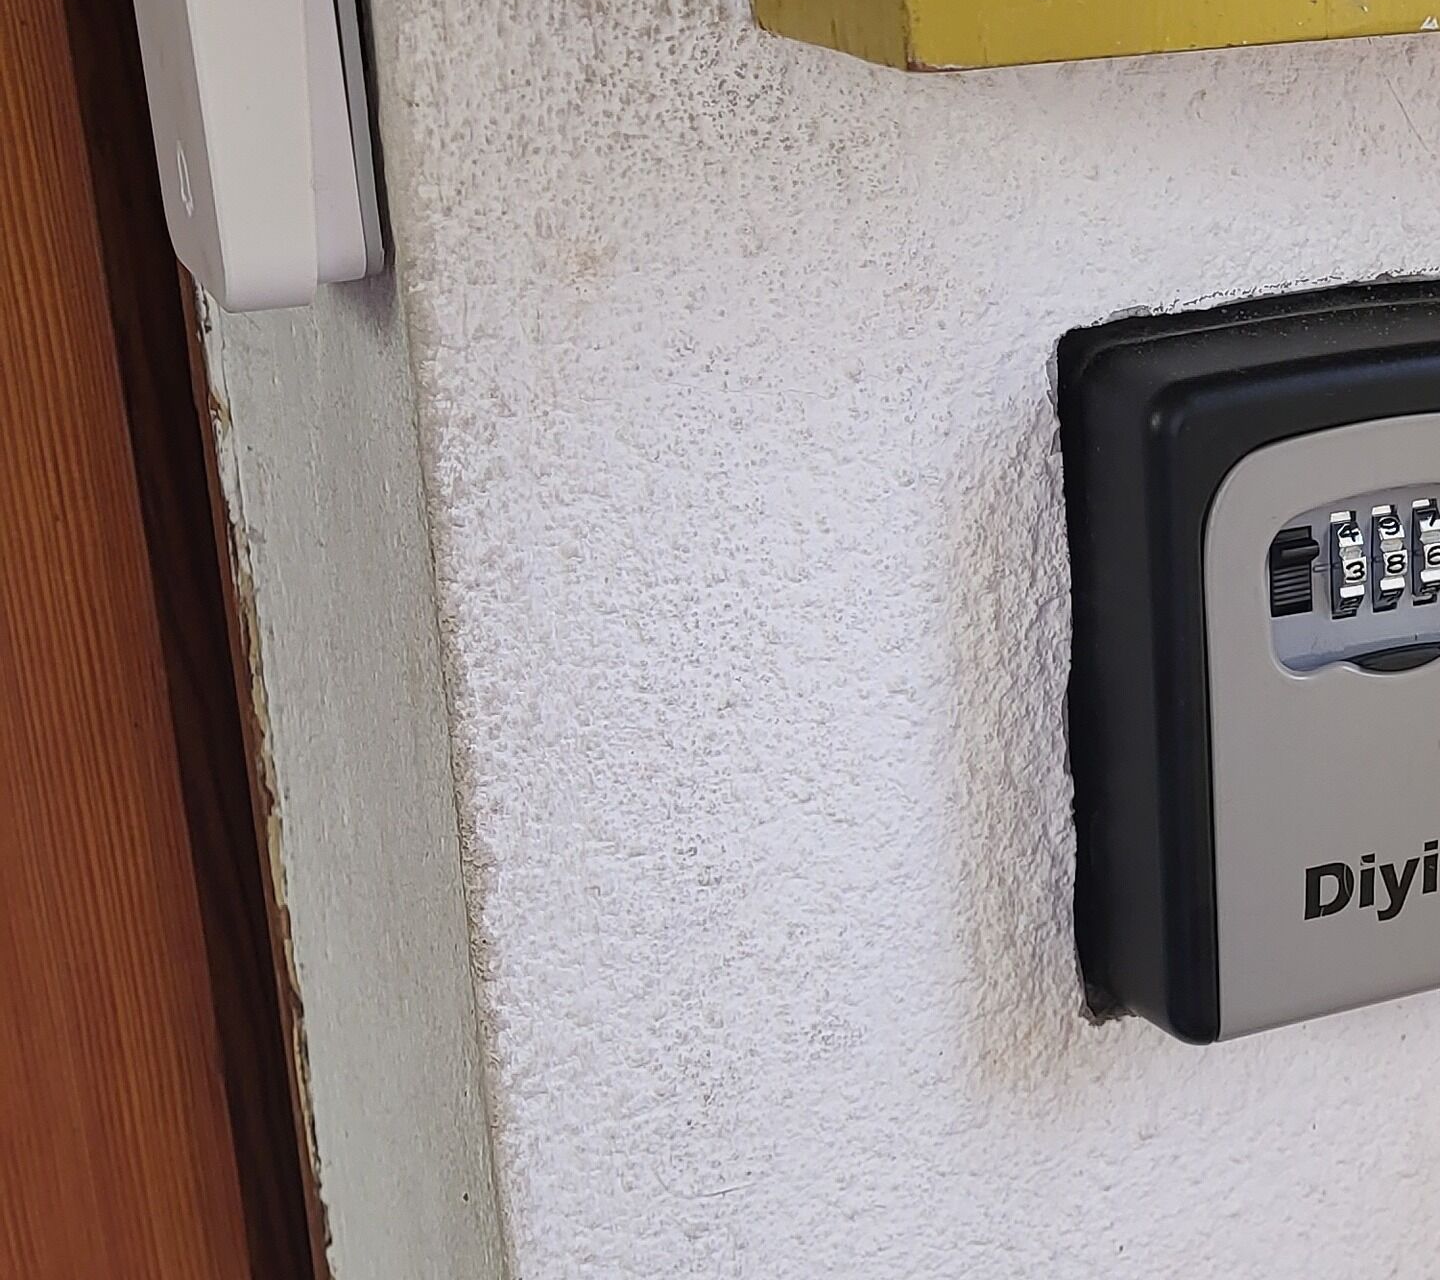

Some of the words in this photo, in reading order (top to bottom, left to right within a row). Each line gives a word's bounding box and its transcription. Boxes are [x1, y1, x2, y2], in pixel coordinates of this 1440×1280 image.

[1338, 523, 1359, 543] 4
[1345, 561, 1365, 581] 3
[1387, 553, 1406, 574] 8
